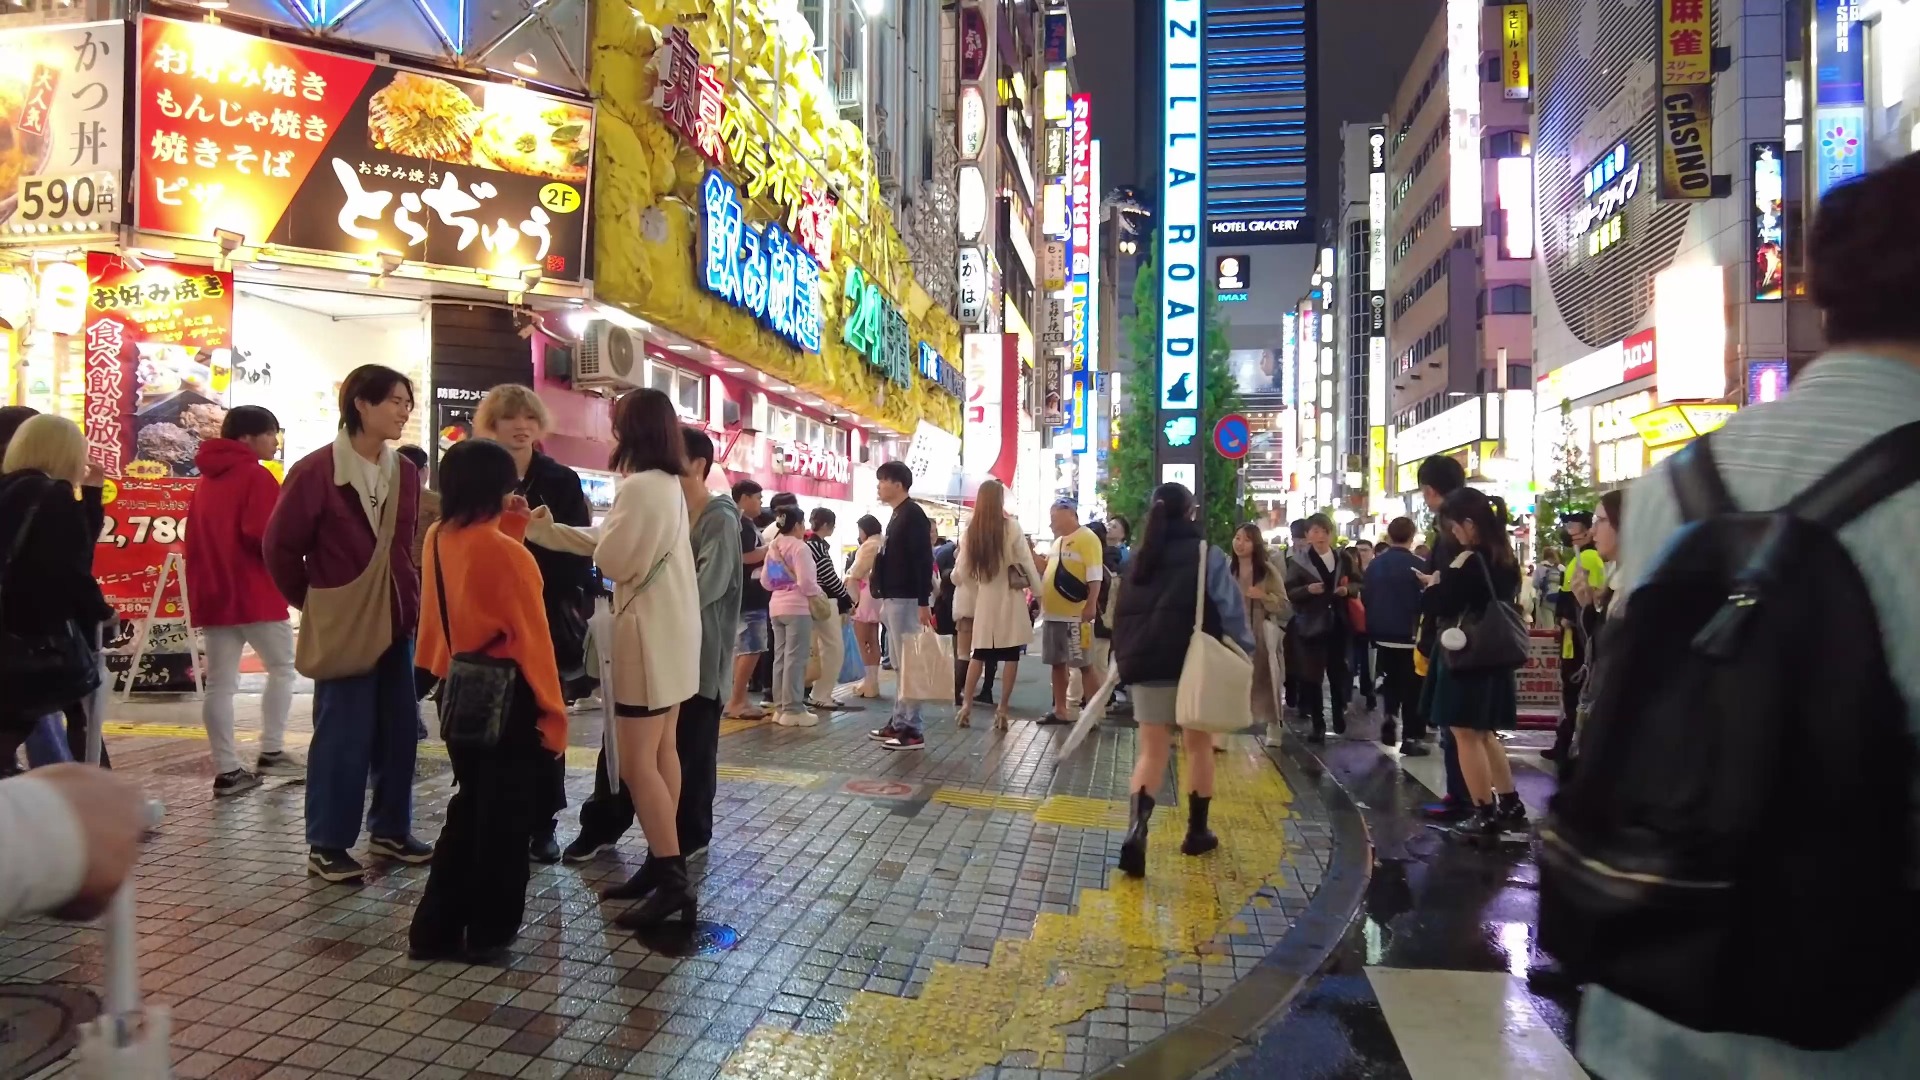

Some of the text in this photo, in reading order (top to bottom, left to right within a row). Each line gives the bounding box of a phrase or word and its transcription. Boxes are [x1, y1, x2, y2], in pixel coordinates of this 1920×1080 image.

[1508, 10, 1519, 48] 生ビール
[22, 66, 53, 132] 大人気
[154, 42, 328, 102] お好み焼き
[1169, 0, 1198, 188] ZILLA
[69, 32, 110, 167] かつ丼
[156, 88, 328, 142] もんじゃ焼き
[151, 129, 295, 178] 焼きそば
[1664, 93, 1709, 190] CASINO
[22, 176, 114, 221] 590円
[155, 176, 224, 208] ピザ
[358, 160, 440, 186] お好み焼き
[547, 188, 573, 207] 2F
[331, 156, 551, 261] とらぢゅう
[1212, 219, 1300, 233] HOTEL GRACERY
[704, 173, 820, 352] 飲み放題
[92, 274, 223, 309] お好み焼き
[963, 308, 976, 317] B1
[1167, 224, 1195, 357] ROAD
[1217, 293, 1248, 302] IMAX
[87, 319, 124, 481] 食べ飲み放題
[968, 343, 986, 424] トラノコ
